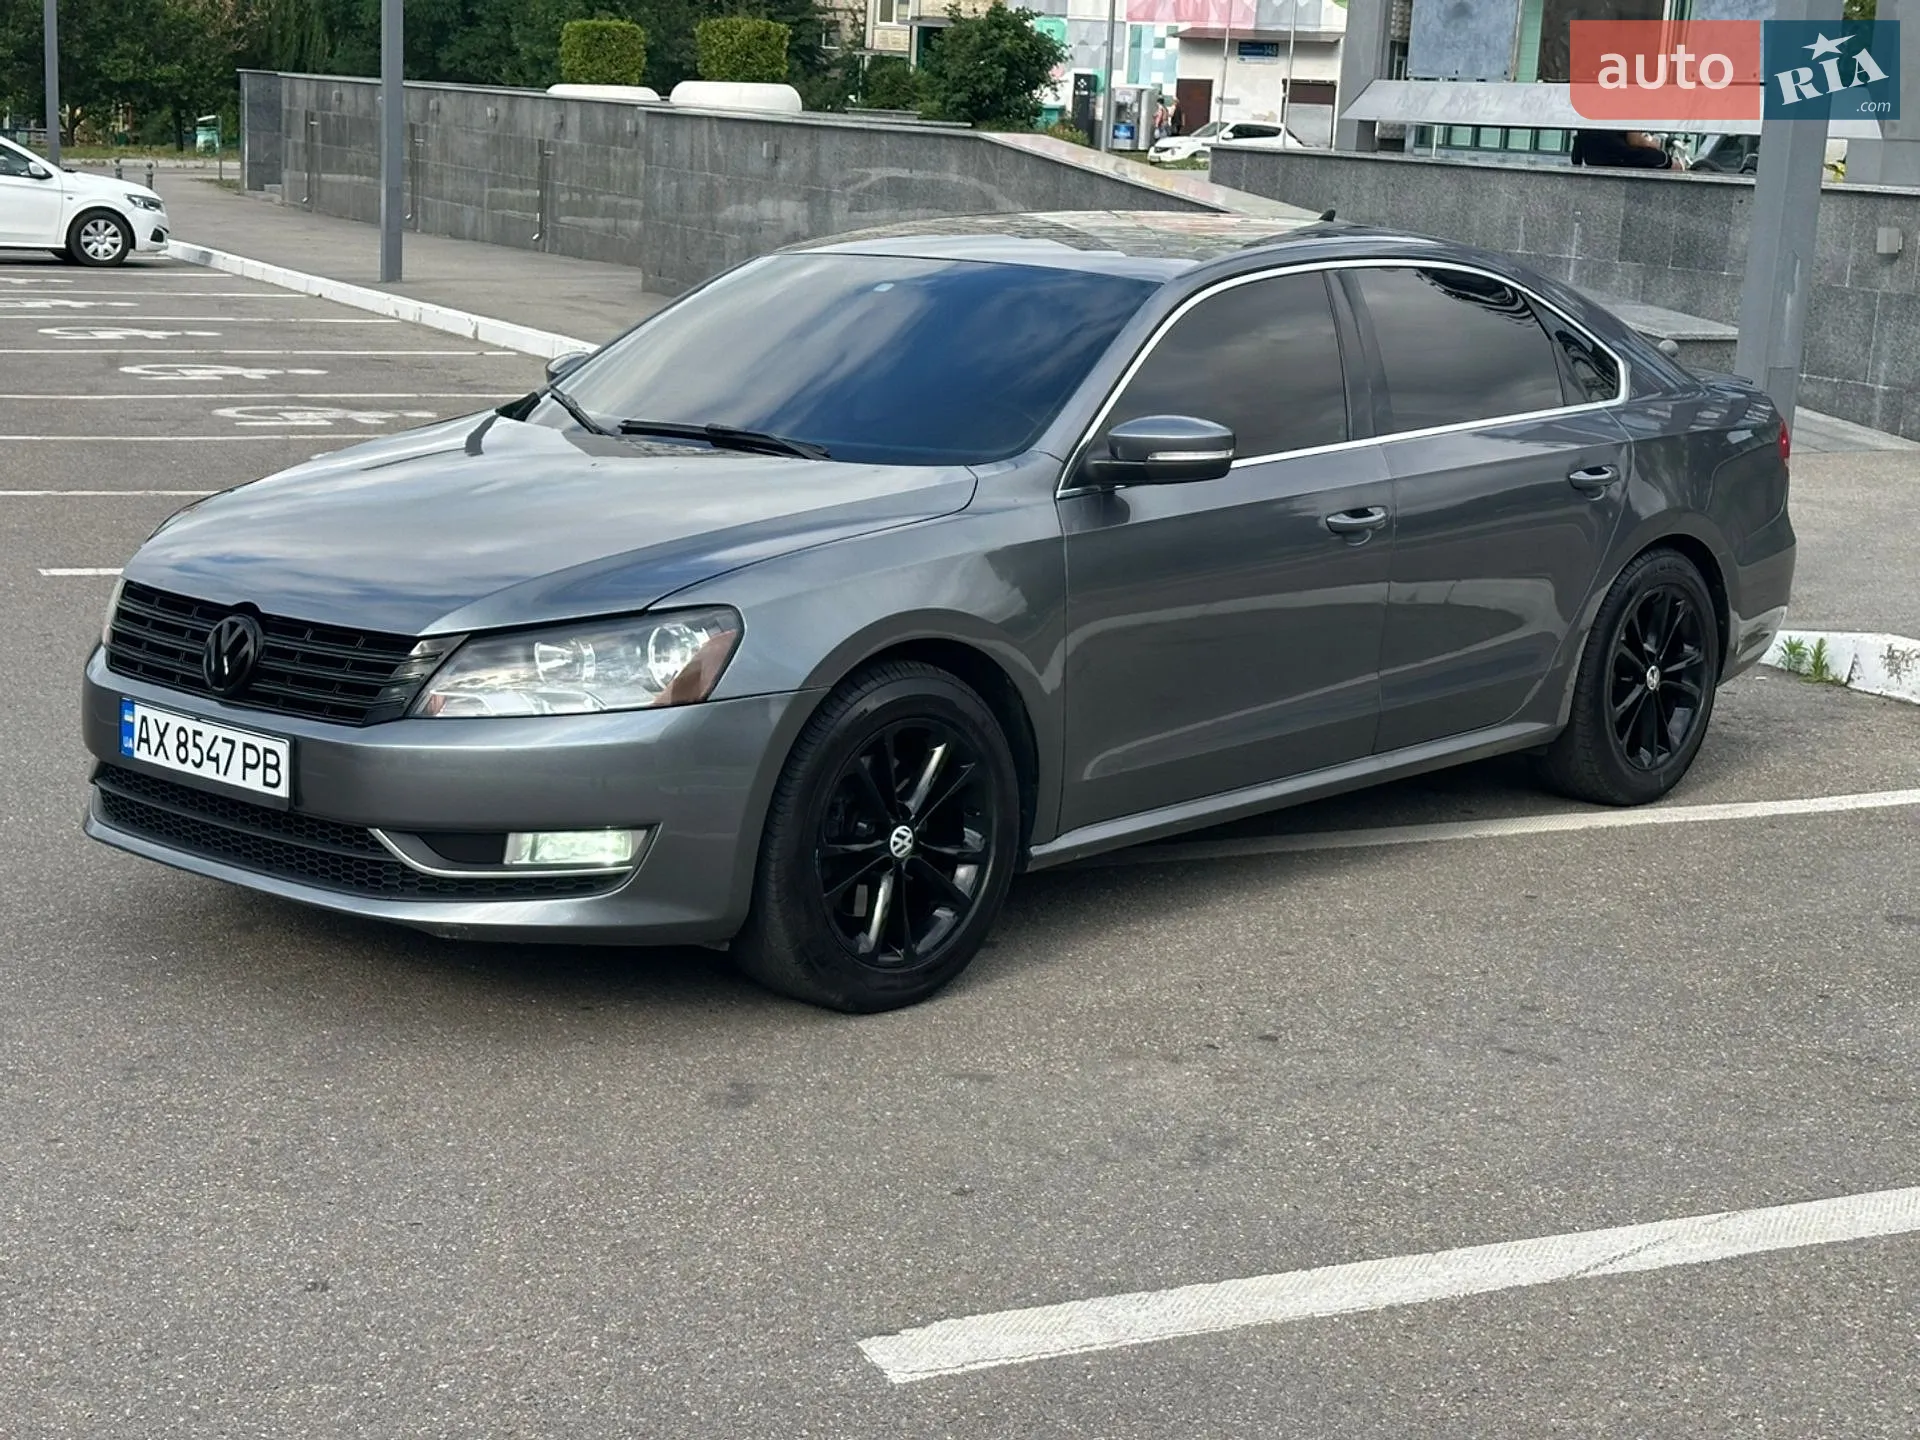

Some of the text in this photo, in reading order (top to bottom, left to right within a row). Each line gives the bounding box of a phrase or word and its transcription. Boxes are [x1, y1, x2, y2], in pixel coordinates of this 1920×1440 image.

[136, 715, 282, 789] AX 8547 PB
